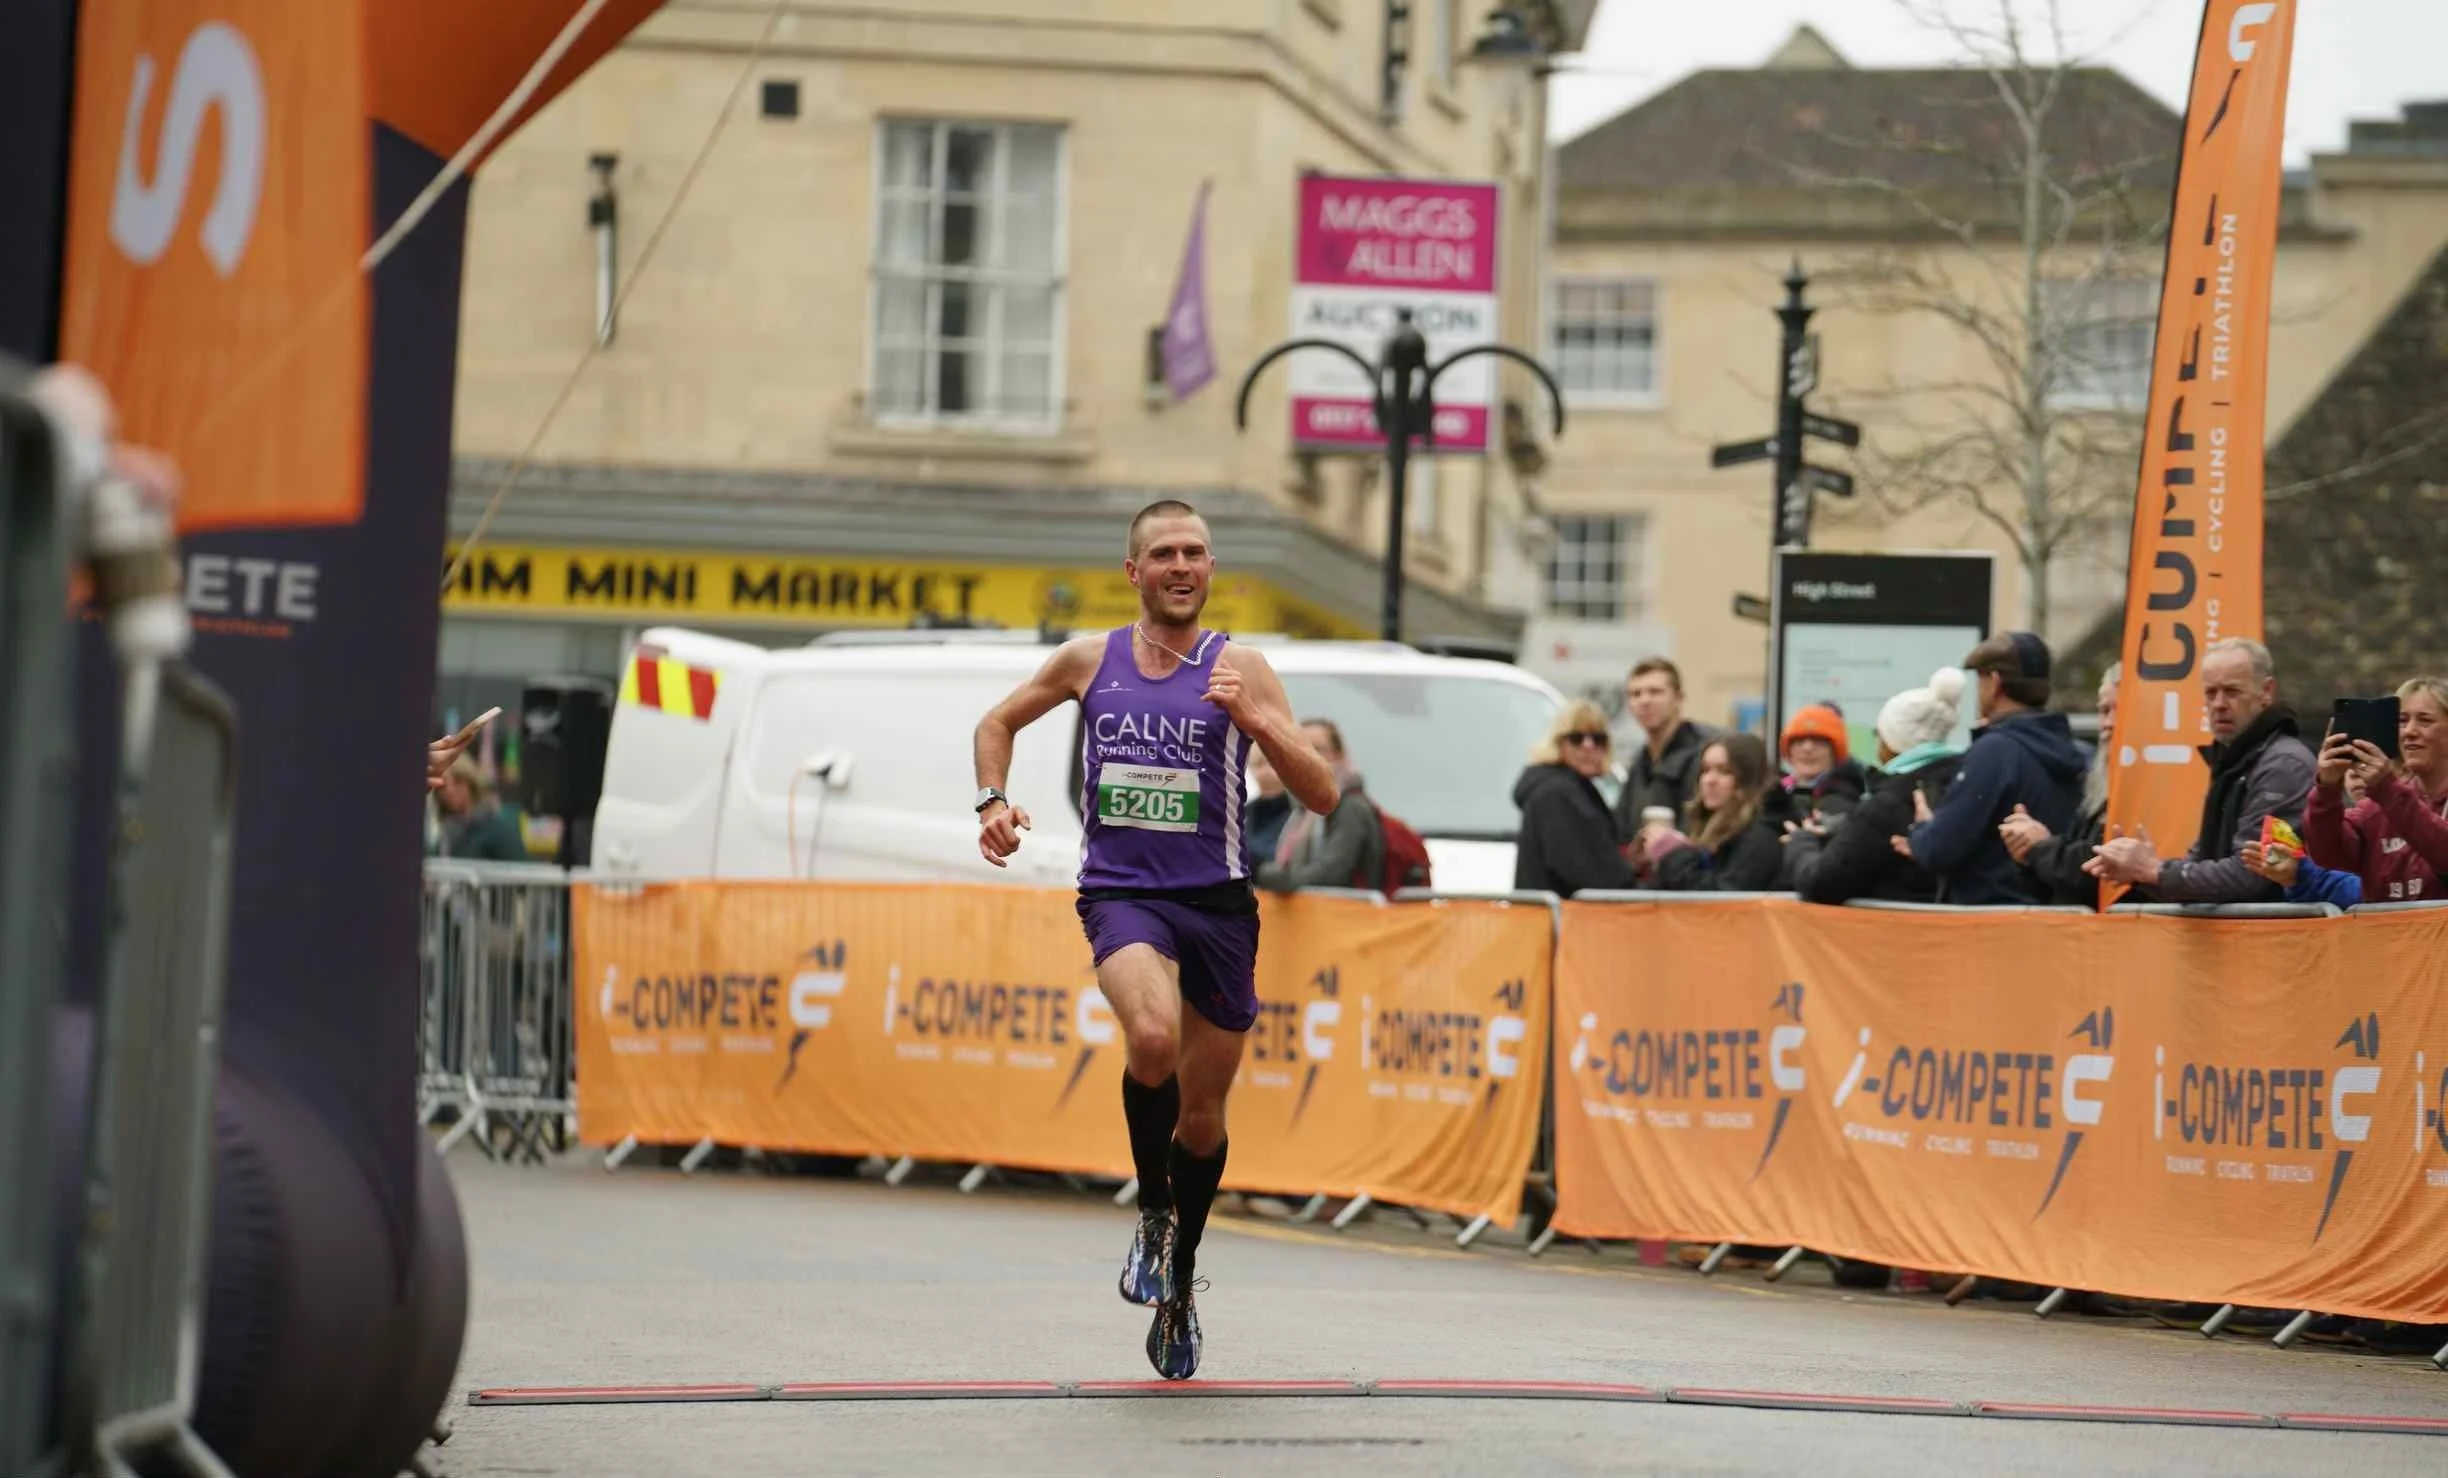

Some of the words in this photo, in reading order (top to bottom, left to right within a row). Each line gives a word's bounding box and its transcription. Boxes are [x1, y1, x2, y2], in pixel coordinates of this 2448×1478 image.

[1319, 194, 1476, 239] MAGGS
[1346, 239, 1475, 281] ALLEN
[2210, 212, 2238, 381] TRIATHLON
[2207, 427, 2228, 553] CYCLING
[566, 560, 698, 604] MINI
[732, 564, 981, 613] MARKET
[1792, 580, 1828, 603] High
[1830, 581, 1877, 600] Street
[1095, 711, 1207, 749] CALNE
[1096, 741, 1158, 761] Running
[1163, 743, 1204, 765] Club
[1109, 787, 1185, 822] 5205
[601, 964, 780, 1032] i-COMPETE
[883, 962, 1069, 1044] i-COMPETE
[1569, 1012, 1764, 1099] i-COMPETE
[1832, 1025, 2055, 1129] i-COMPETE
[2153, 1044, 2324, 1151] i-COMPETE
